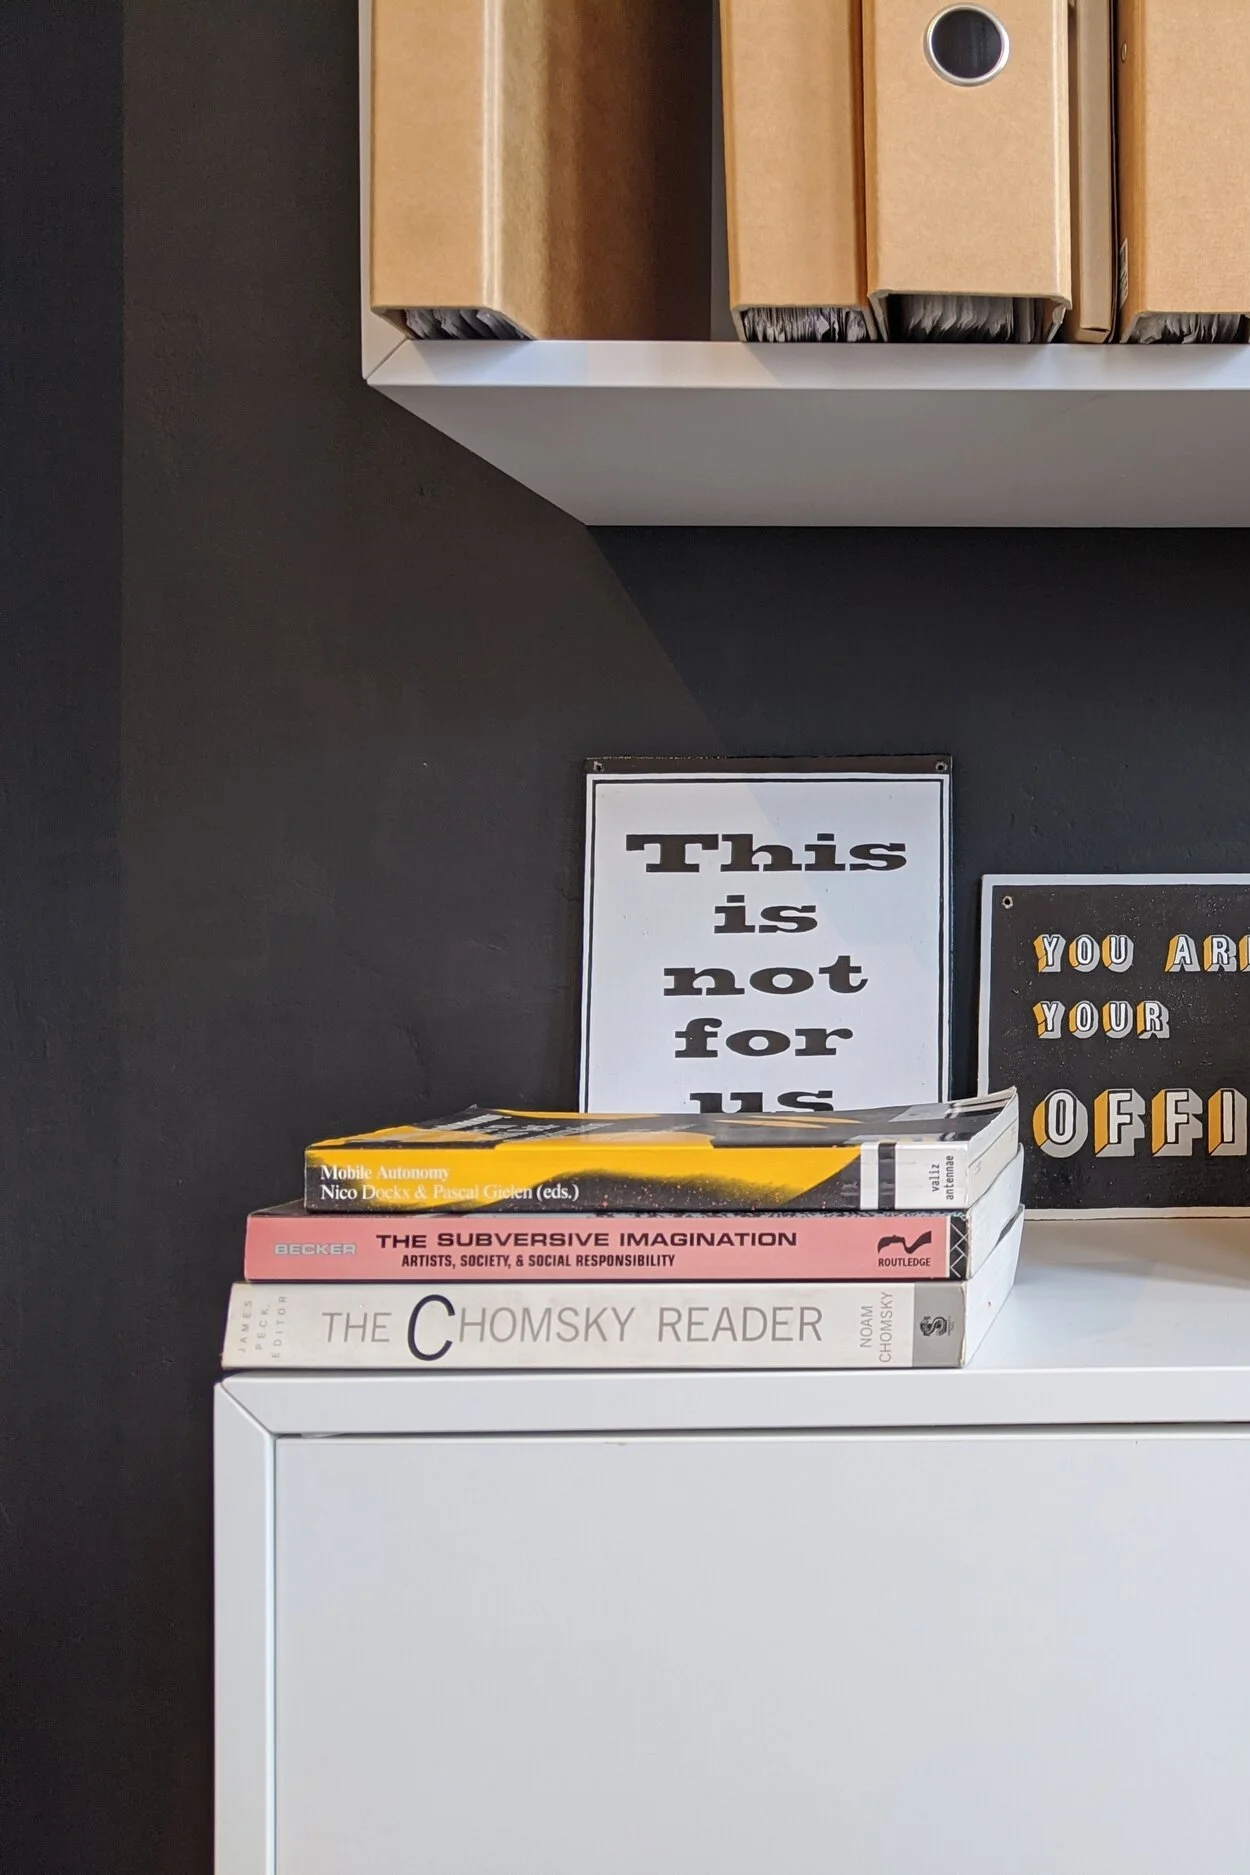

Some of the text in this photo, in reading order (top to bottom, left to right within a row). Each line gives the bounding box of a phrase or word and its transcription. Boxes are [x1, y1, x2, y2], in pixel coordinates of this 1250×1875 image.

[625, 833, 907, 873] This
[714, 894, 818, 934] is
[1033, 934, 1134, 973] YOU
[663, 955, 869, 996] not
[674, 1017, 853, 1059] for
[1032, 1000, 1170, 1039] YOUR
[689, 1090, 834, 1114] us
[320, 1164, 450, 1182] Mobile Autonomy
[931, 1163, 940, 1192] valiz
[946, 1155, 954, 1201] antennae
[320, 1184, 580, 1202] Nico Dockx & Pascal Gielen (eds.)
[274, 1243, 357, 1256] BECKER
[376, 1231, 797, 1249] THE SUBVERSIVE IMAGINATION
[401, 1253, 675, 1269] ARTISTS, SOCIETY, & SOCIAL RESPONSIBILITY
[878, 1257, 931, 1267] ROUTLEDGE
[238, 1300, 252, 1353] JAMES
[271, 1295, 287, 1359] EDITOR
[322, 1294, 824, 1361] THE CHOMSKY READER
[859, 1305, 873, 1348] NOAM
[879, 1291, 895, 1363] CHOMSKY
